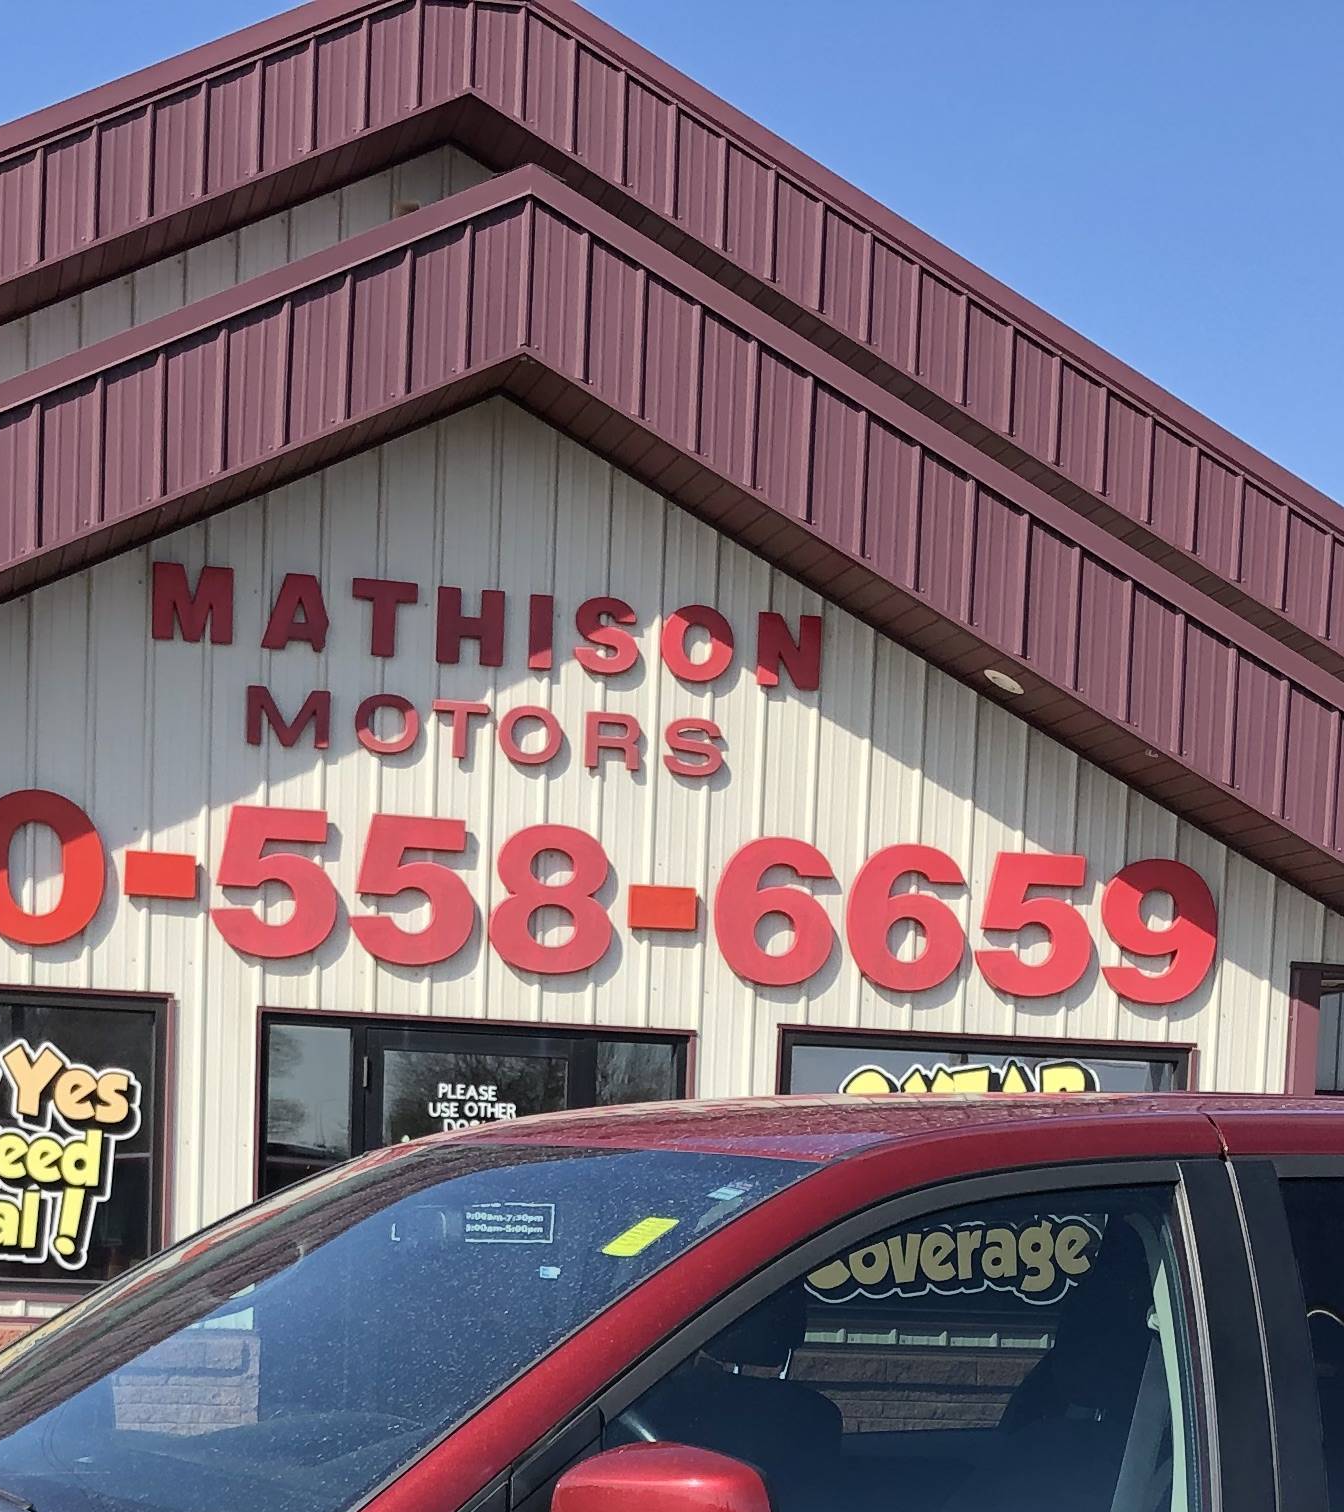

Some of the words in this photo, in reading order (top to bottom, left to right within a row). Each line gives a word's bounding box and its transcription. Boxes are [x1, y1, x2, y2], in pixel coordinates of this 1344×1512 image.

[151, 561, 822, 691] MATHISON
[246, 684, 725, 777] MOTORS
[3, 1045, 130, 1124] Yes
[428, 1102, 460, 1118] USE
[464, 1102, 517, 1120] OTHER
[438, 1083, 498, 1101] PLEASE
